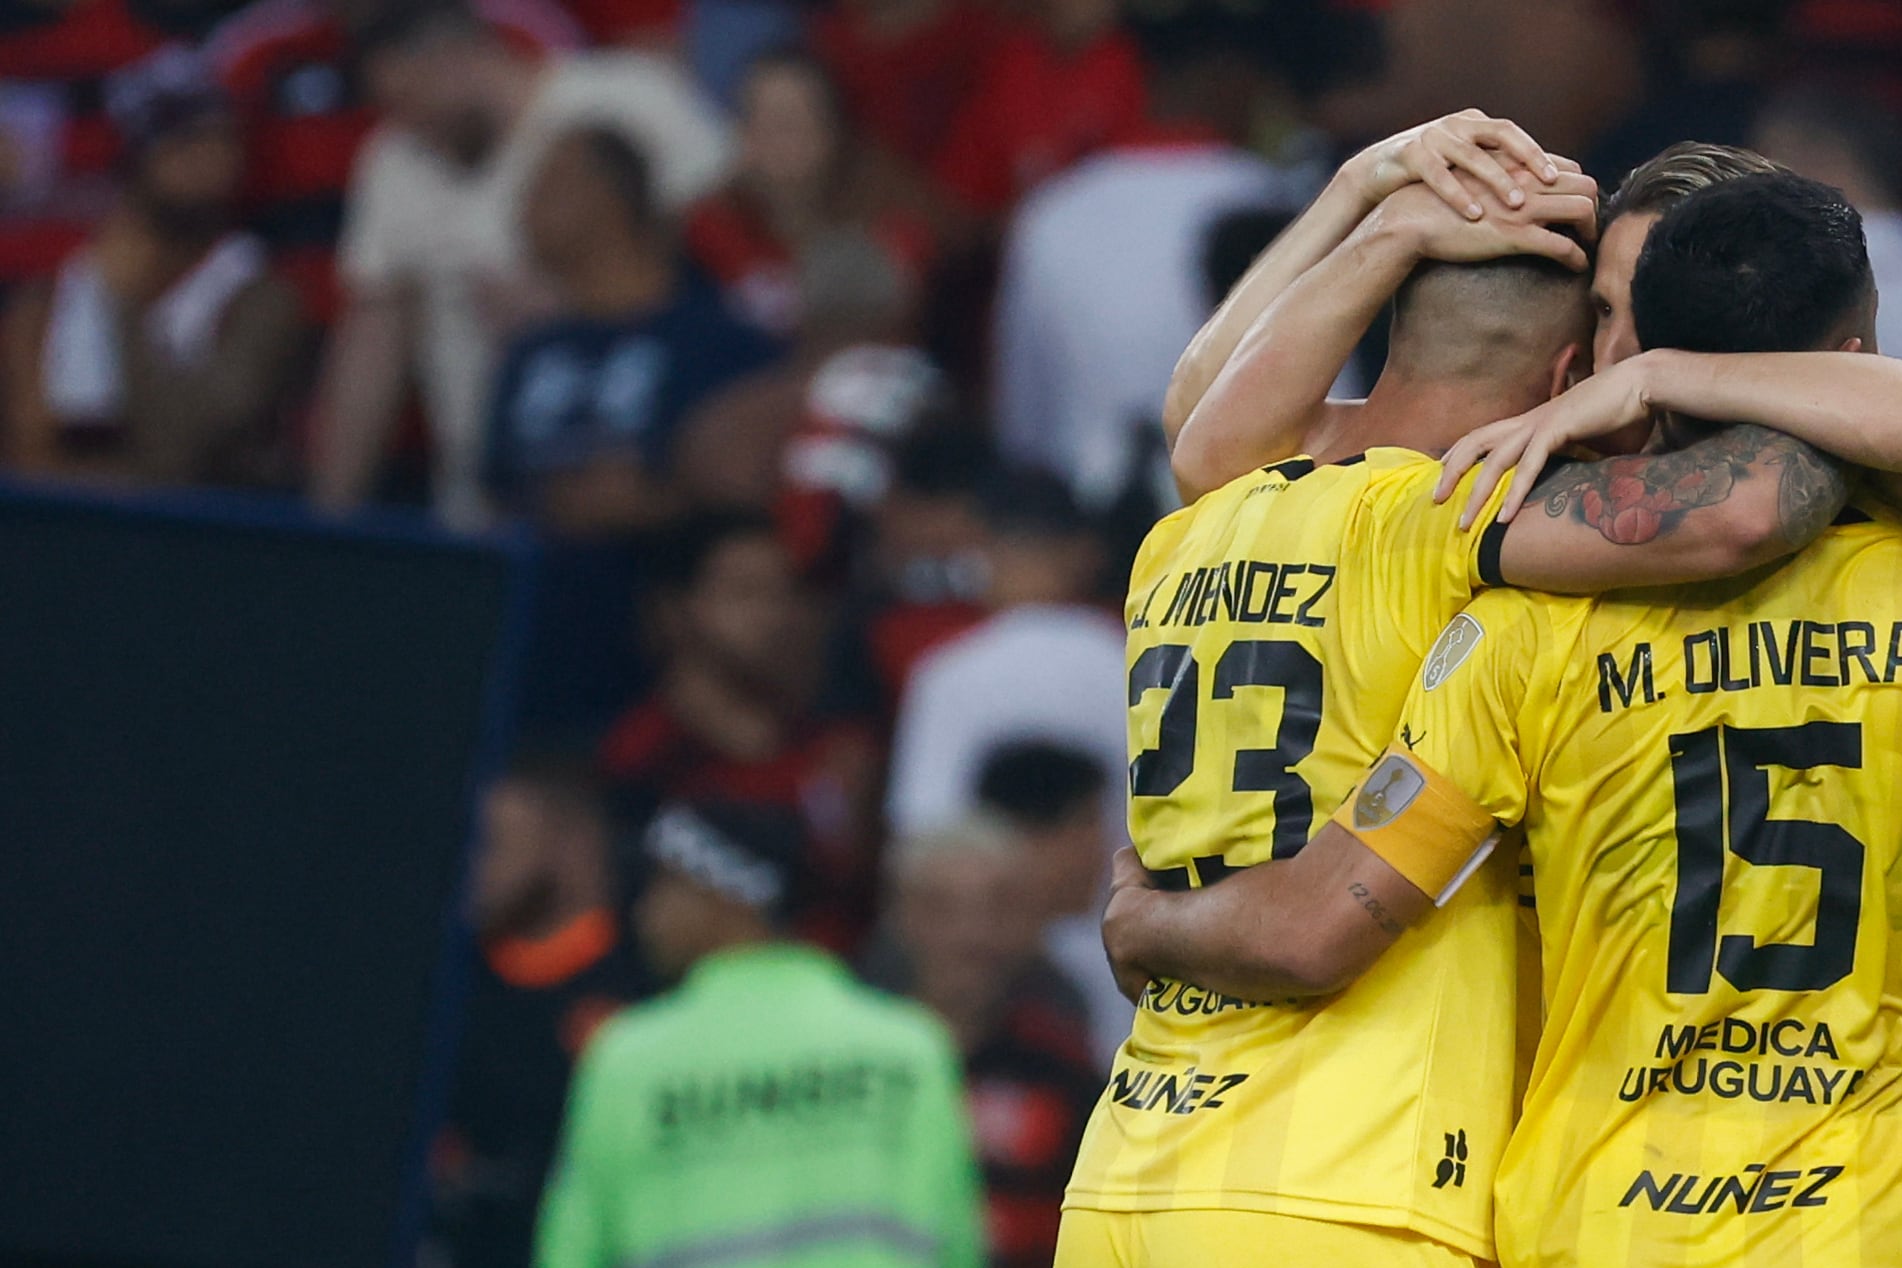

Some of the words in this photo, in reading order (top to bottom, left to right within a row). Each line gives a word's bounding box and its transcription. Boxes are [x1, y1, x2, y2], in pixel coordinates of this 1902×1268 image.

[1160, 560, 1337, 628] MENDEZ
[1597, 642, 1666, 713] M.
[1129, 640, 1324, 890] 23
[1667, 721, 1866, 994] 15
[1617, 1163, 1847, 1216] NUÑEZ
